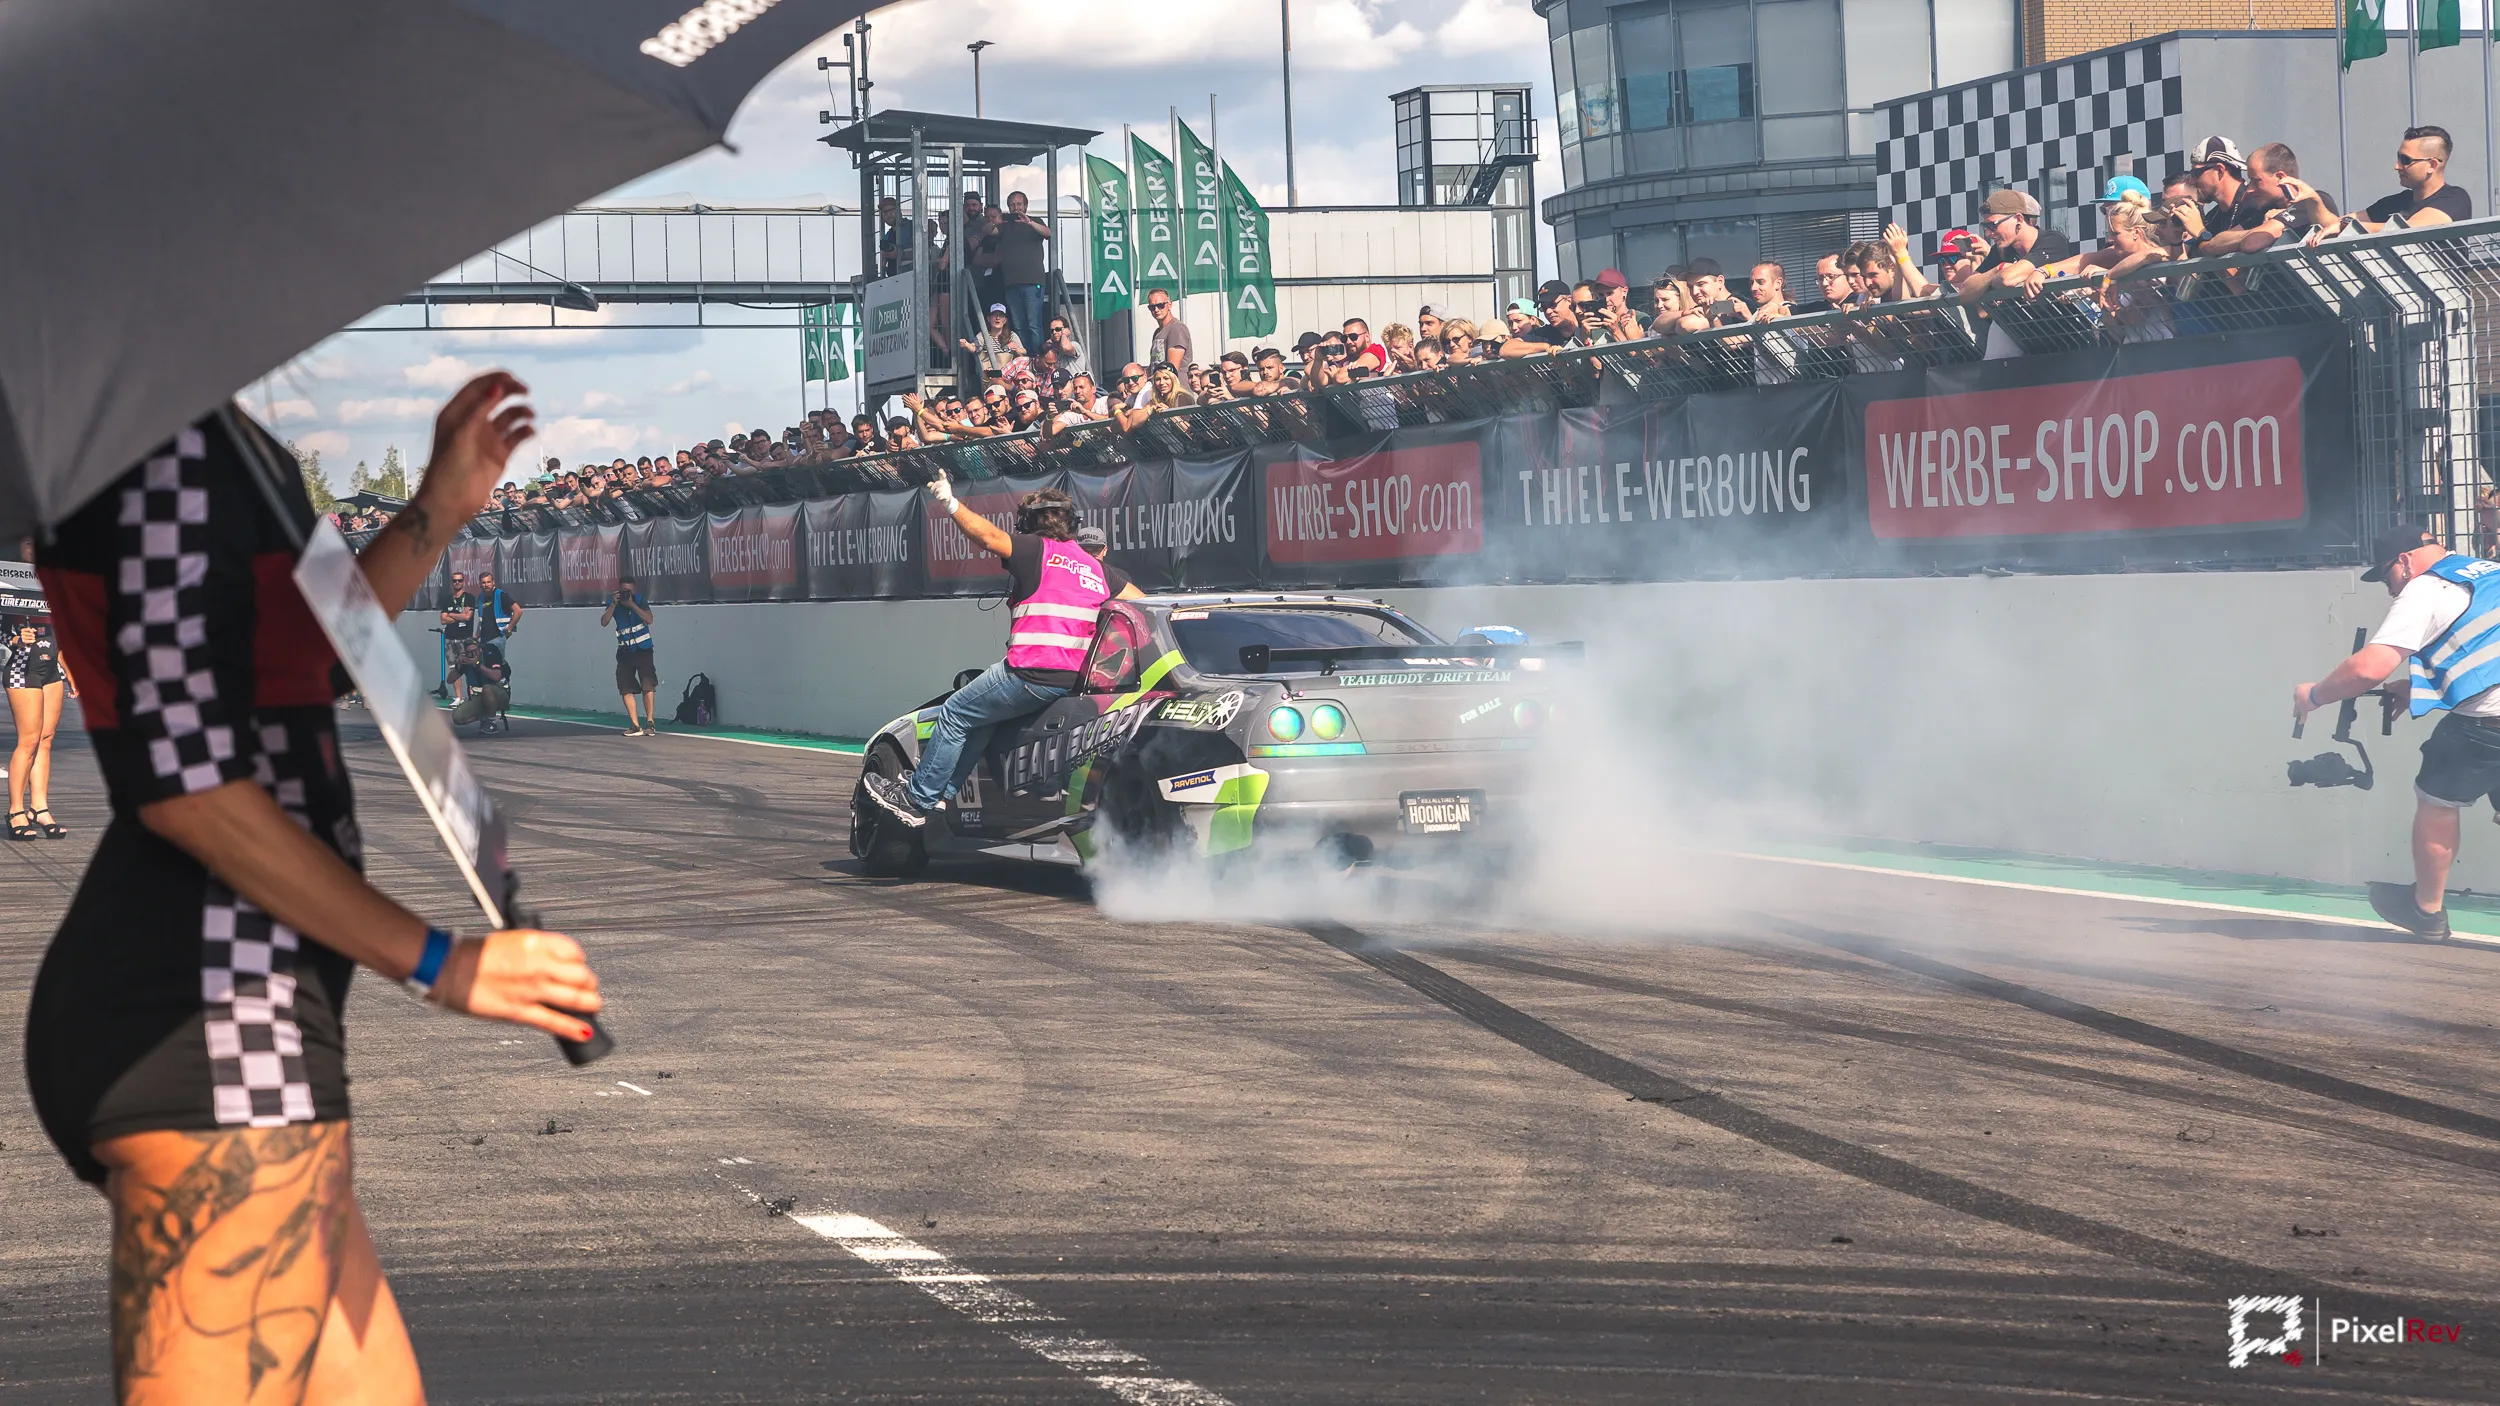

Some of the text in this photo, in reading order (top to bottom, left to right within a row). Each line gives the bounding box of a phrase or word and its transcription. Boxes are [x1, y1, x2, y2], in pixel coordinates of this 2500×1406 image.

[1100, 179, 1123, 260] DEKRA
[1144, 159, 1171, 242] DEKRA
[883, 308, 898, 325] DEKRA
[869, 331, 909, 358] LAUSITZRING
[1878, 409, 2283, 509] WERBE-SHOP.com
[1519, 446, 1811, 526] THIELE-WERBUNG
[1273, 474, 1473, 541] WERBE-SHOP.com
[712, 533, 791, 573] WERBE-SHOP.com
[807, 524, 908, 567] THIELE-WERBUNG
[1079, 575, 1106, 595] CREW
[1338, 674, 1376, 687] YEAH
[1378, 672, 1425, 685] BUDDY
[1432, 671, 1474, 683] DRIFT
[1476, 670, 1511, 682] TEAM
[1459, 697, 1502, 724] FOR SALE
[1000, 697, 1164, 796] YEAH BUDDY
[1173, 773, 1211, 789] RAVENOL
[961, 811, 981, 822] MEYLE
